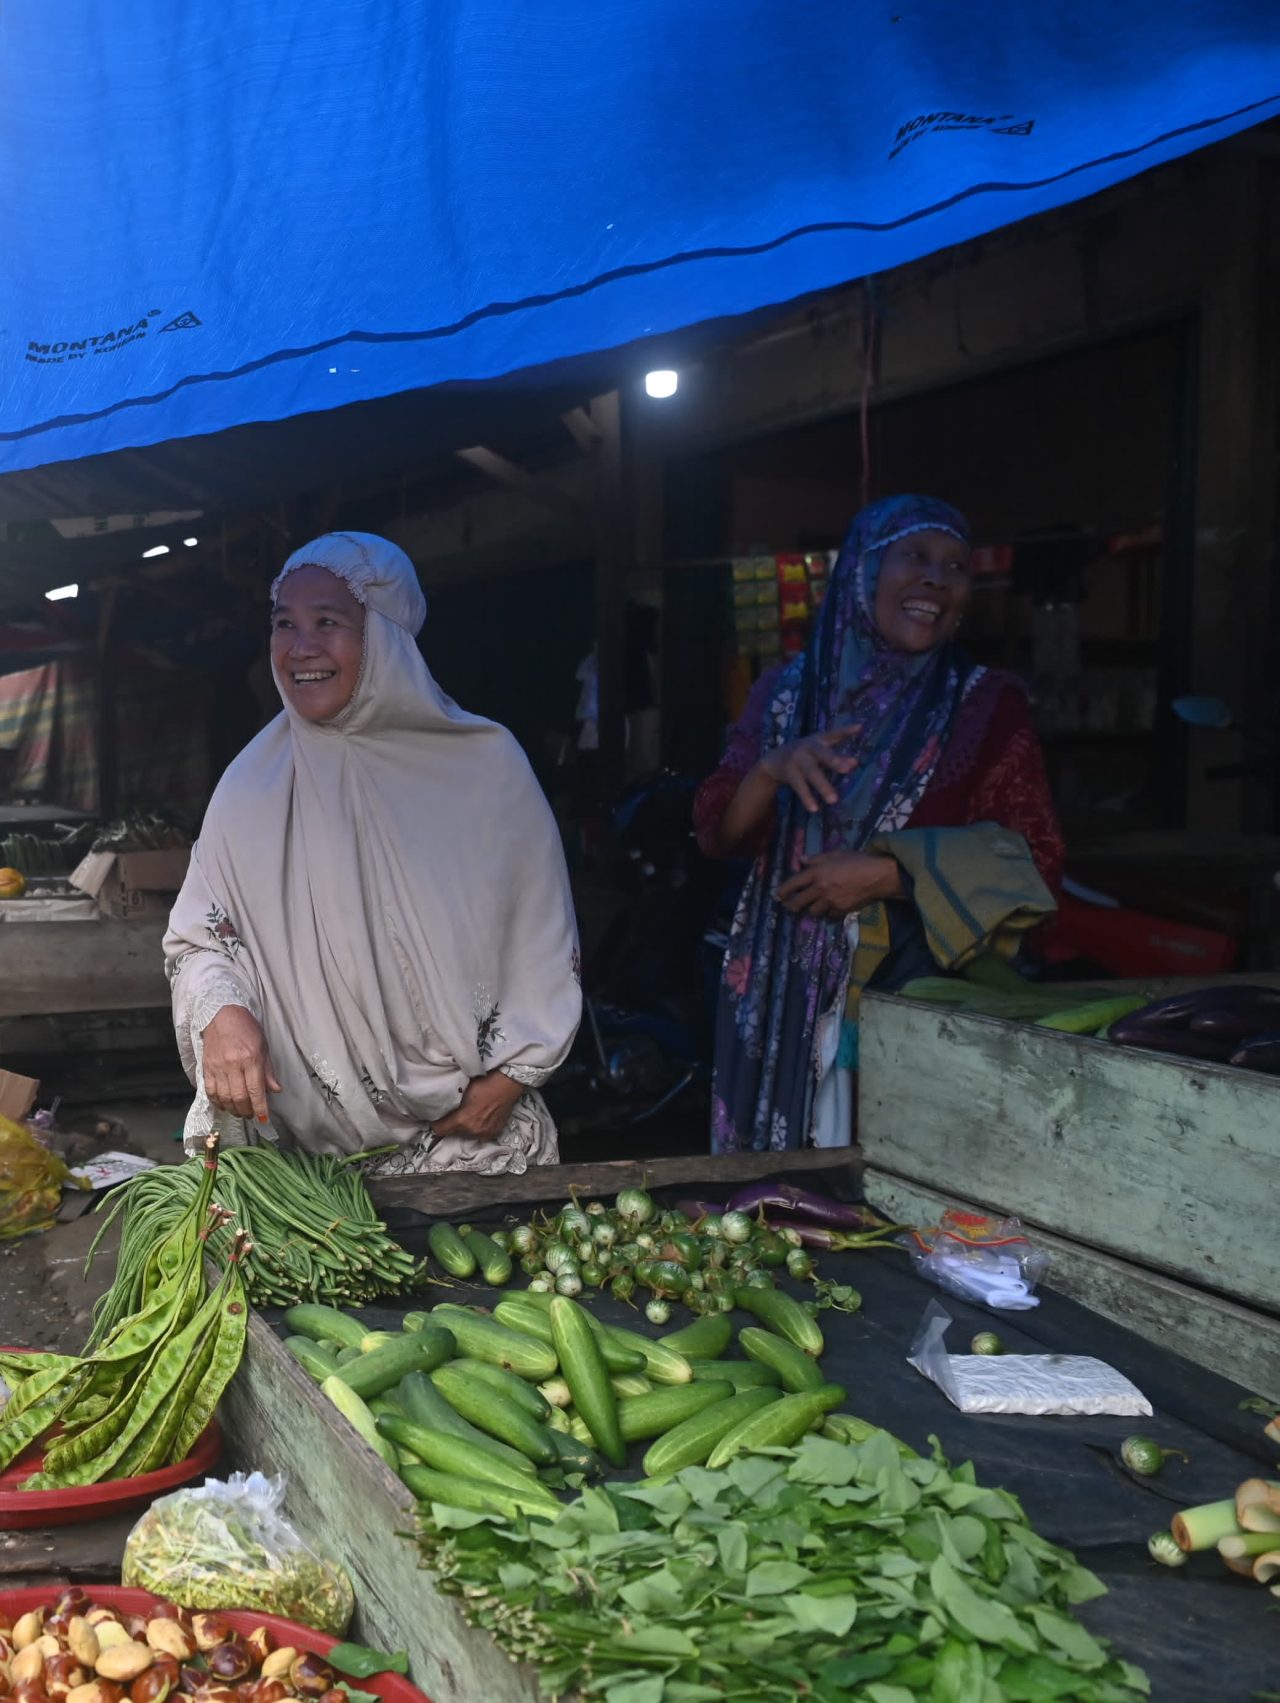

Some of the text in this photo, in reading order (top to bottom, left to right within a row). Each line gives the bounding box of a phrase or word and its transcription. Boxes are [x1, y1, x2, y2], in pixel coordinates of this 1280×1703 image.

[27, 318, 149, 354] MONTANA
[25, 353, 65, 364] MADE
[68, 352, 87, 360] BY
